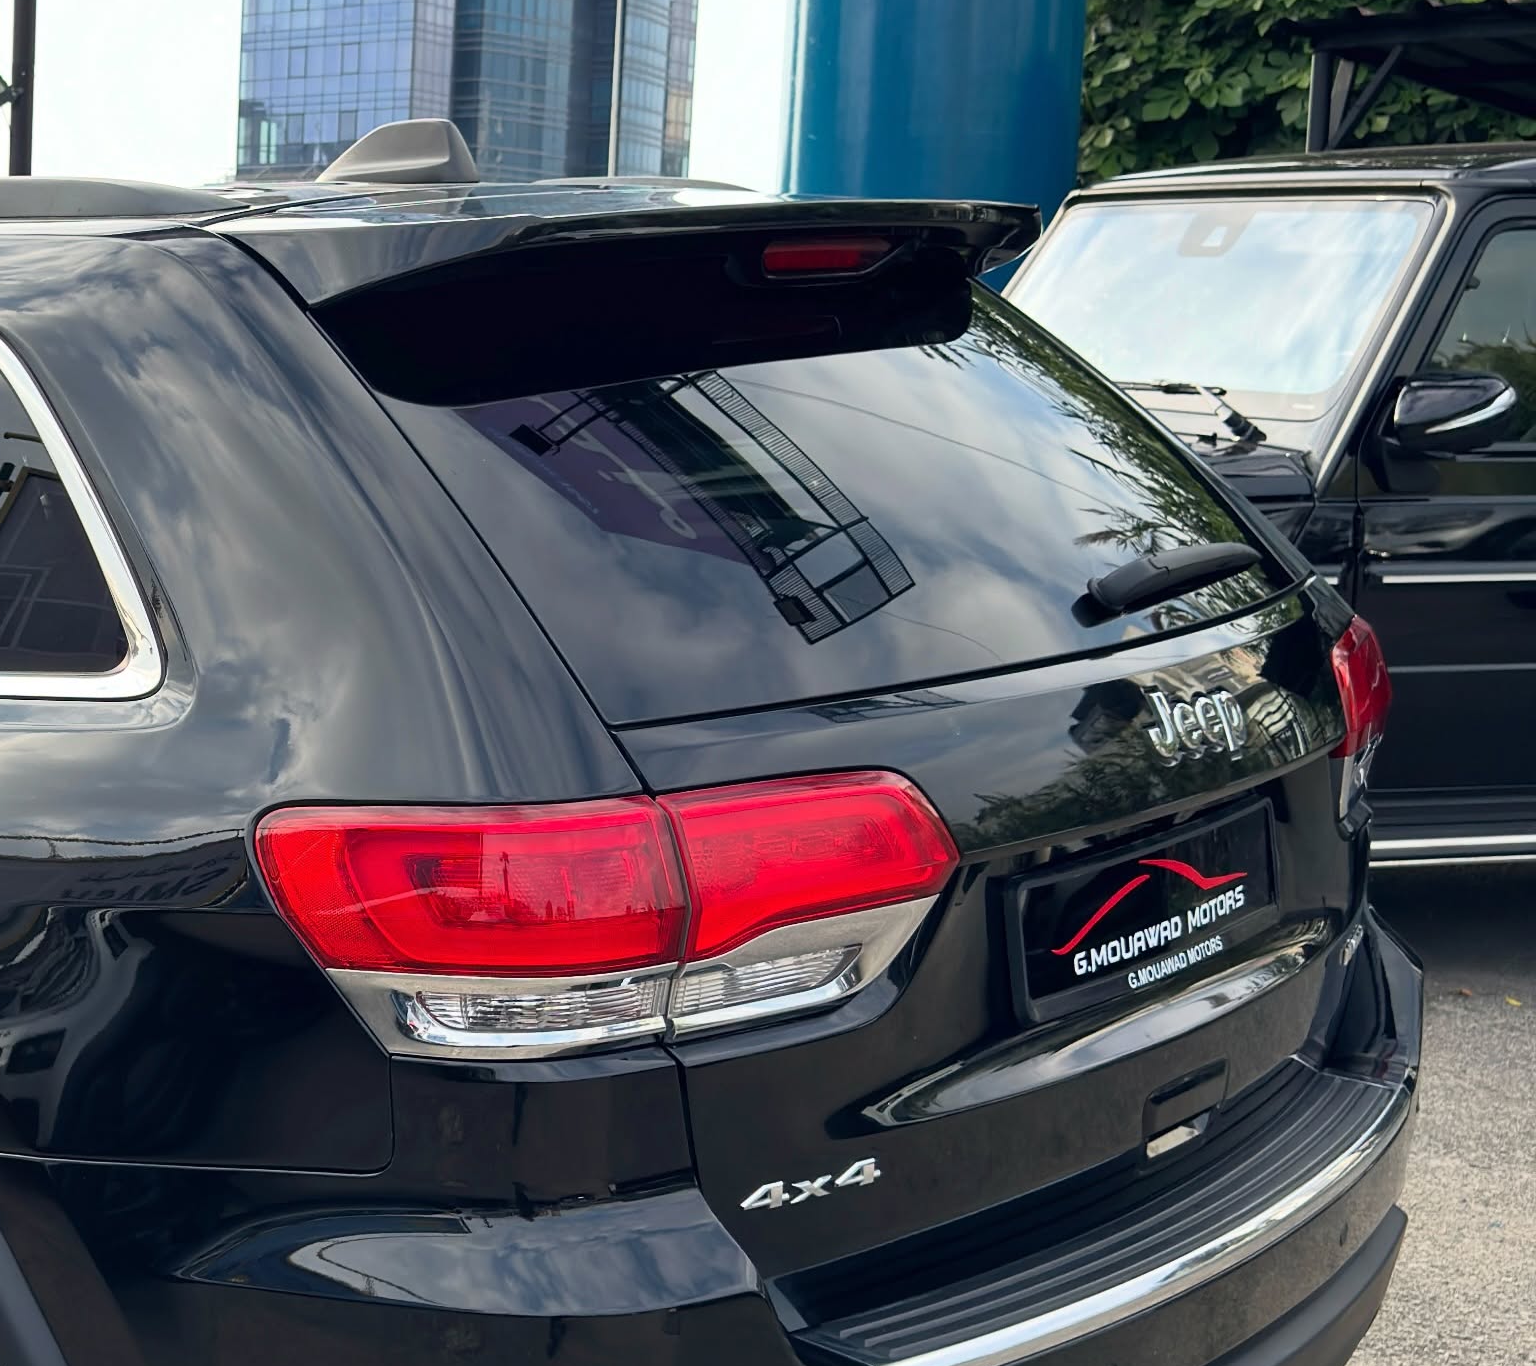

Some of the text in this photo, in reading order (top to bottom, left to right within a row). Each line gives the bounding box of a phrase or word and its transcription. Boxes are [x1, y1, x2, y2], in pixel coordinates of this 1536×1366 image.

[1146, 688, 1248, 761] Jeep
[1073, 885, 1244, 976] G.MOUAWAD MOTORS
[1127, 935, 1224, 989] G.MOUAWAD MOTORS
[740, 1157, 882, 1211] 4x4
